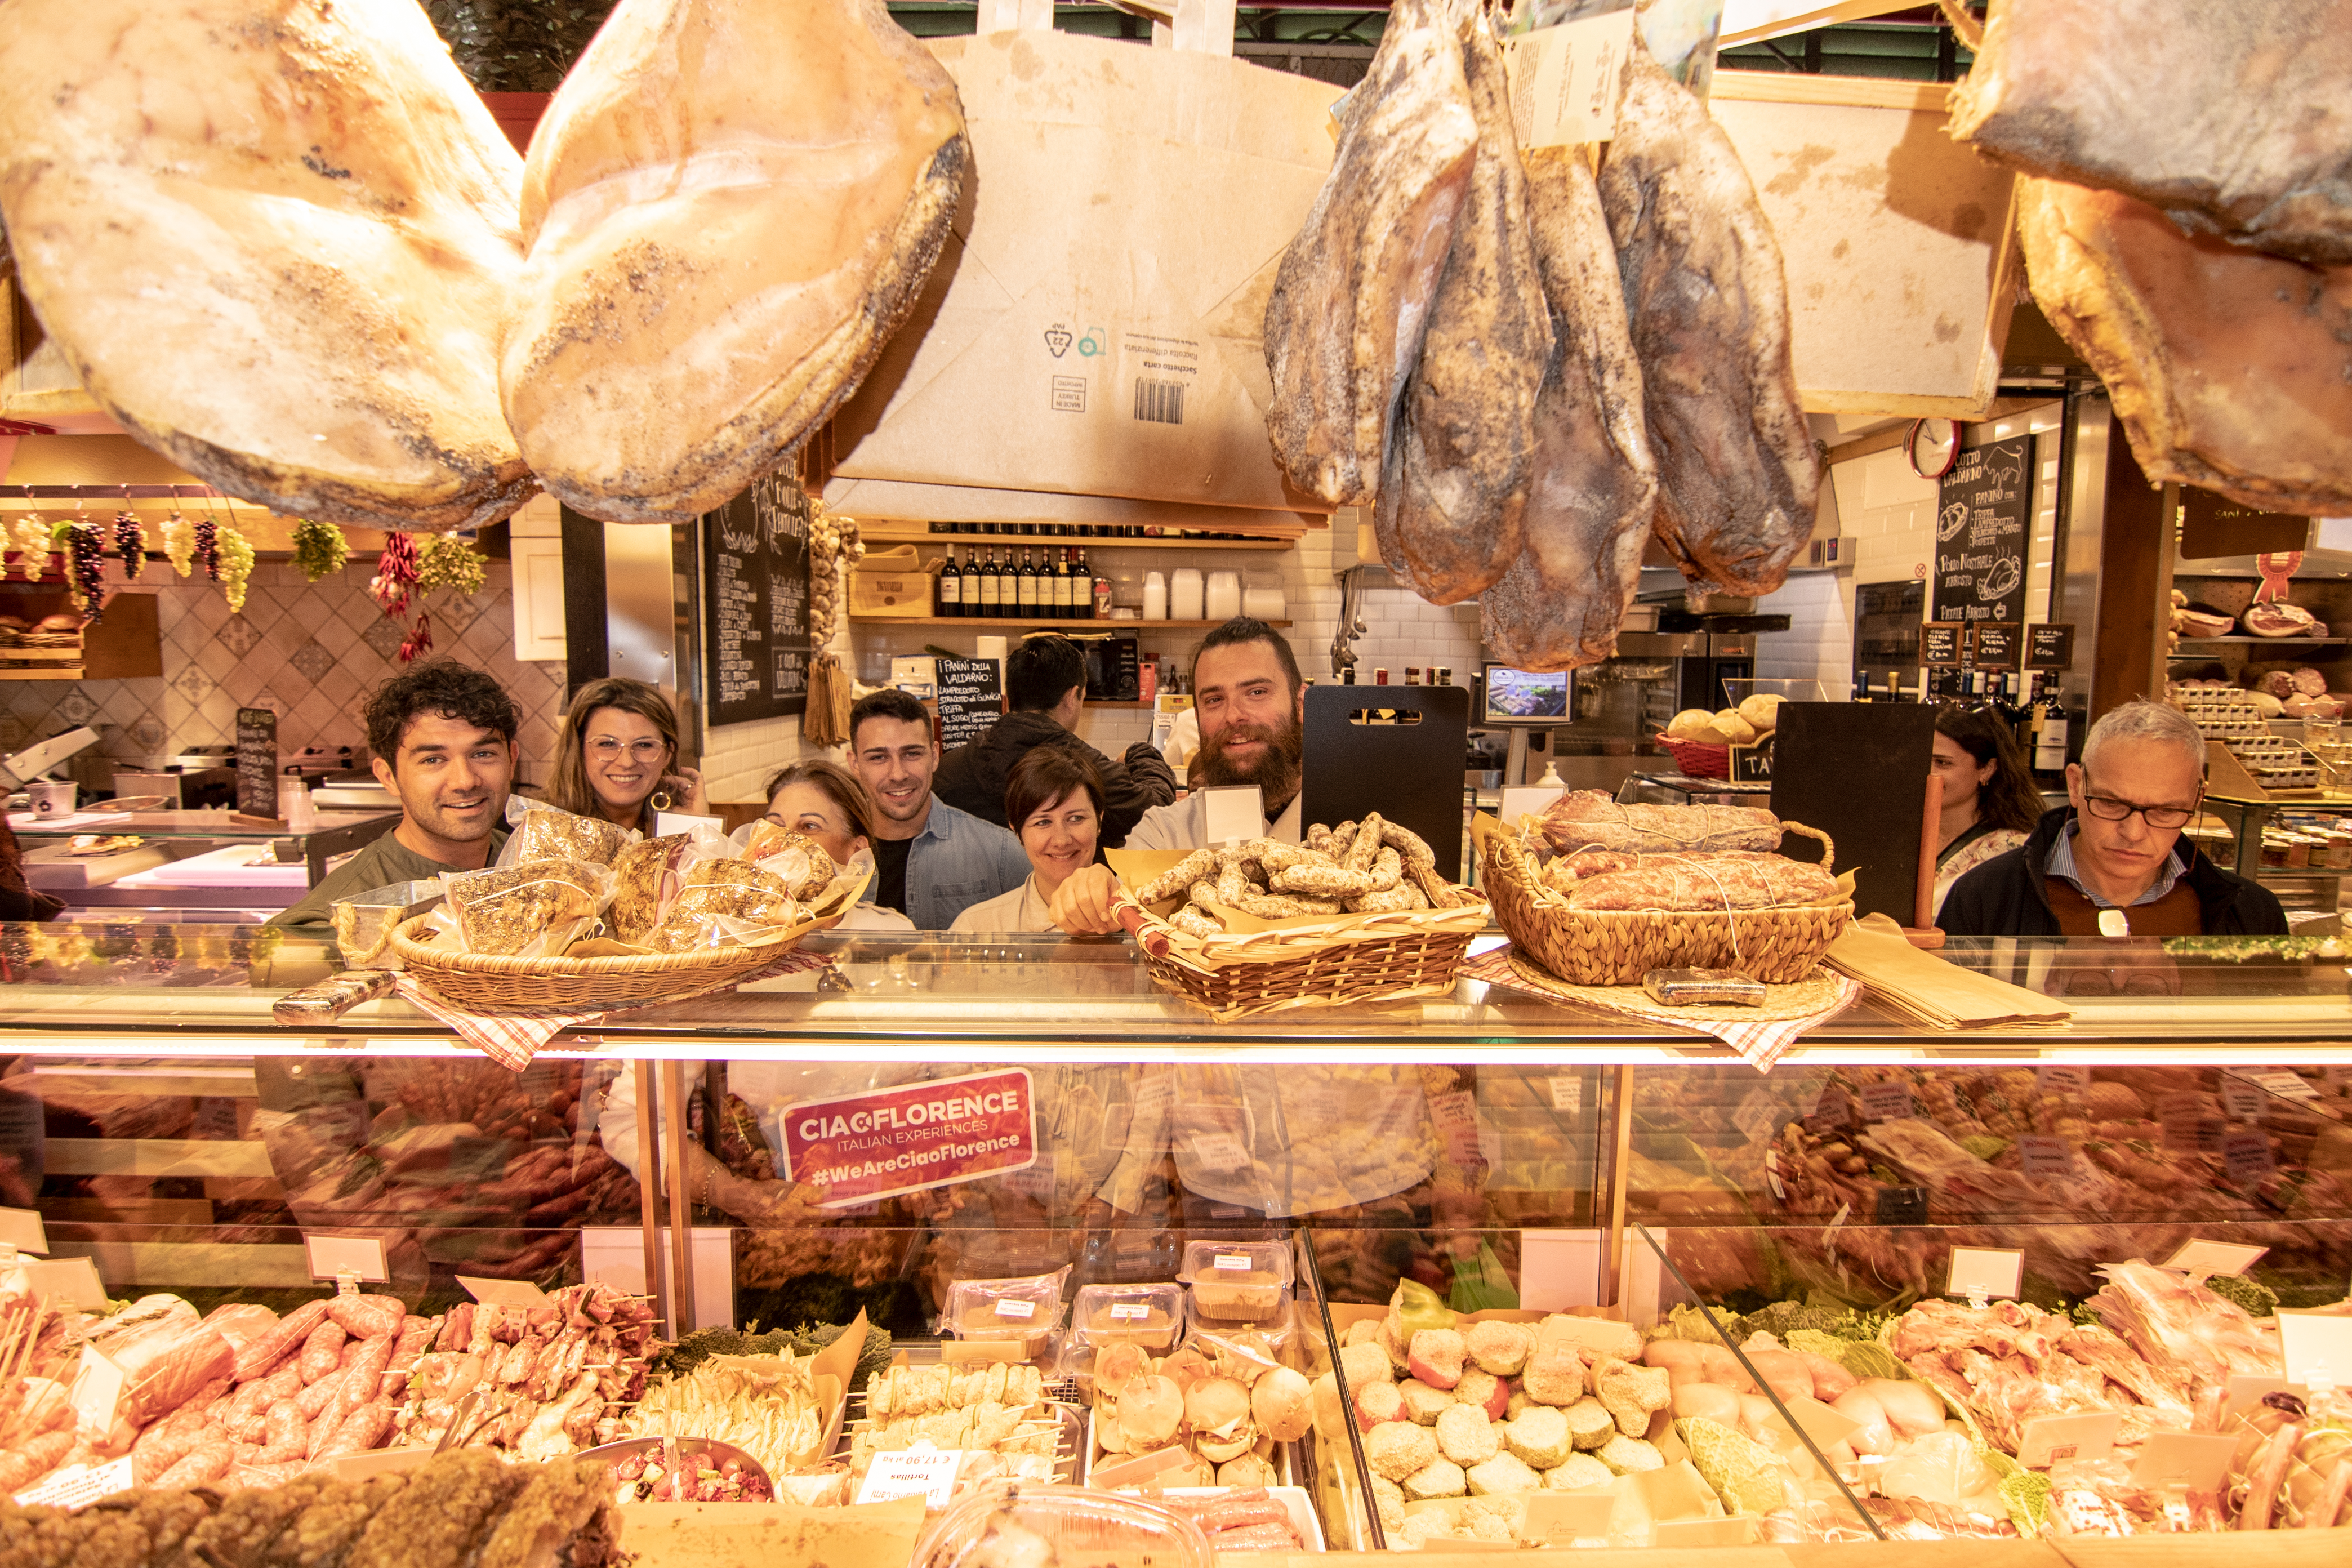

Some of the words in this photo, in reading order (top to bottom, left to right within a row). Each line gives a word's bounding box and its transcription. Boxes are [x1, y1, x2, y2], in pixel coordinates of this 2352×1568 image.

[1053, 337, 1064, 346] 22
[1124, 344, 1168, 357] differenziata
[1169, 349, 1198, 361] Raccolta
[1143, 361, 1161, 370] carta
[1162, 363, 1197, 375] Sacchetto
[1975, 488, 2003, 505] PANINO
[1939, 554, 1959, 573] POLLO
[1960, 553, 1993, 571] NOSTRALE
[1945, 574, 1973, 588] ARROSTO
[1940, 604, 1964, 621] PATATE
[1965, 604, 1990, 621] ARROSTO
[971, 662, 990, 671] DELLA
[945, 671, 992, 684] VALDARNO:
[837, 1134, 892, 1153] ITALIAN
[896, 1119, 989, 1144] EXPERIENCES
[811, 1134, 1021, 1187] #WeAreCiaoFlorence
[906, 1455, 938, 1465] 17,90
[942, 1455, 951, 1464] €
[869, 1489, 891, 1501] Carni
[929, 1487, 940, 1499] La
